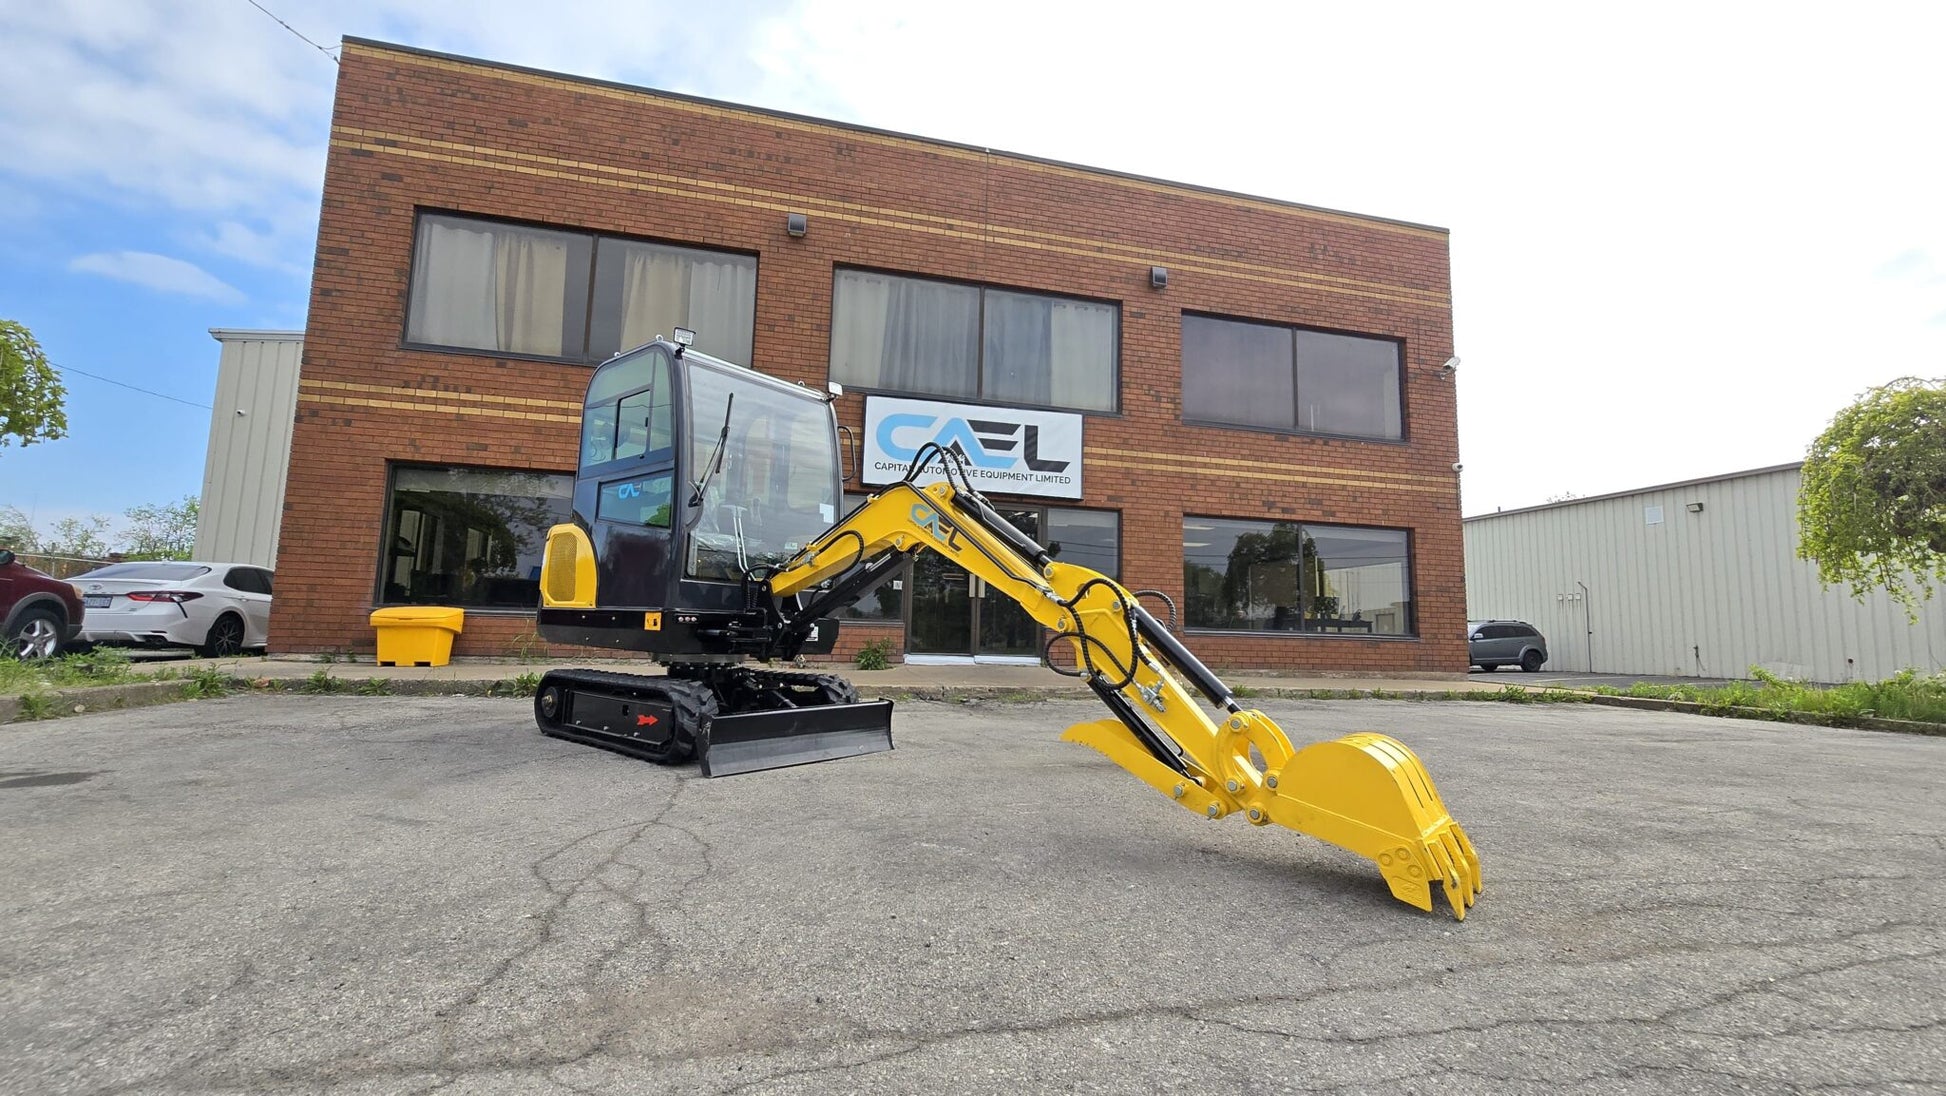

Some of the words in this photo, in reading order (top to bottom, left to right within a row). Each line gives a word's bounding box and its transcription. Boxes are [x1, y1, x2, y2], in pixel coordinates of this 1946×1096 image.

[876, 413, 1070, 473] CAEL
[874, 461, 914, 474] CAPITA
[914, 465, 978, 478] UTOOVE
[980, 470, 1034, 482] EQUIPMENT
[1035, 474, 1071, 485] LIMITED
[911, 503, 962, 552] CAEL
